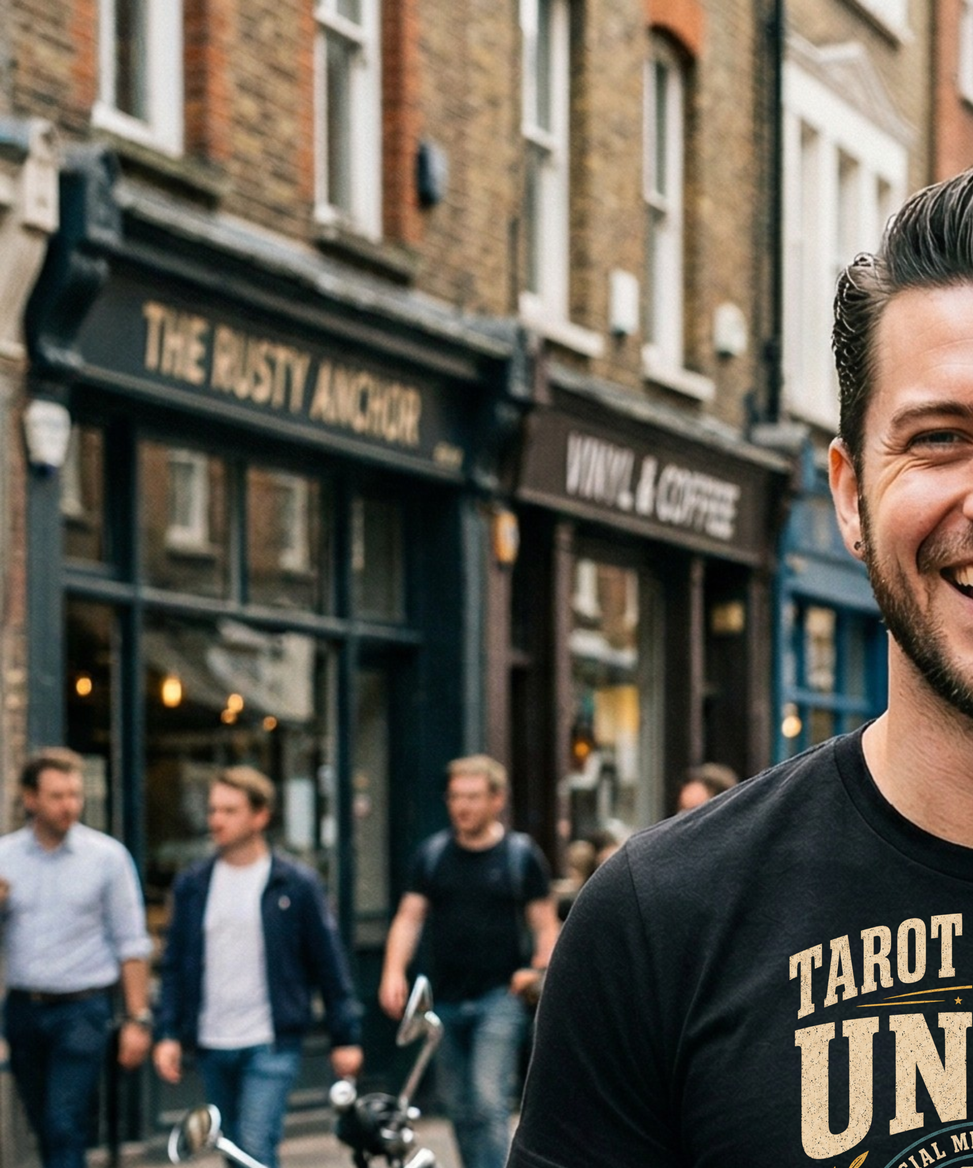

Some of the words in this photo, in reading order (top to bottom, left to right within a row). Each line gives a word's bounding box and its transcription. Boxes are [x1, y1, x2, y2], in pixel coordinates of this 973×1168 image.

[143, 300, 209, 386] THE
[210, 324, 310, 414] RUSTY
[309, 358, 422, 446] ANCHOR
[635, 454, 658, 516] &
[789, 913, 963, 1019] TAROT
